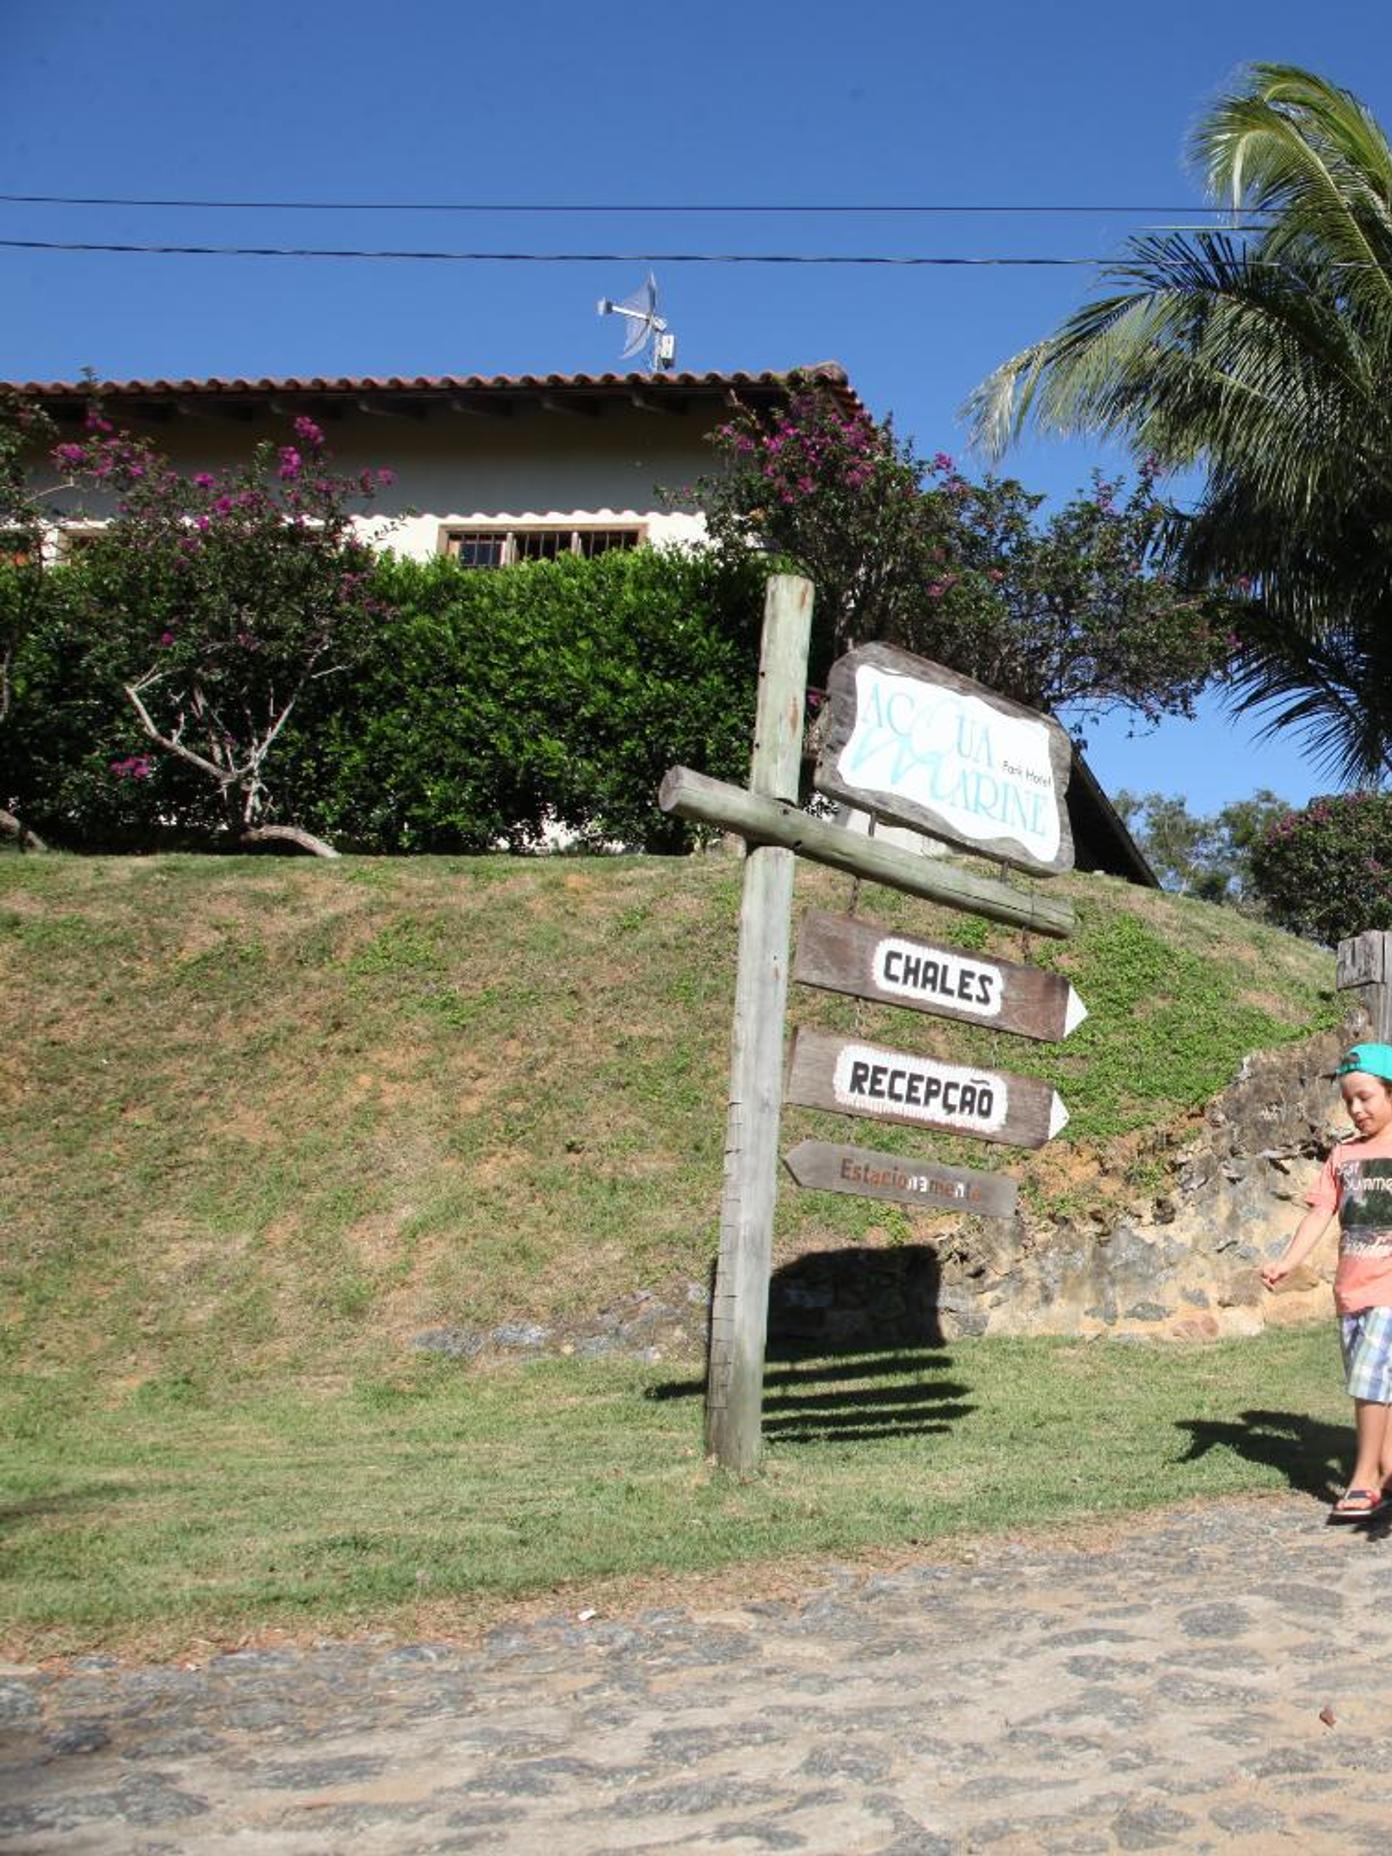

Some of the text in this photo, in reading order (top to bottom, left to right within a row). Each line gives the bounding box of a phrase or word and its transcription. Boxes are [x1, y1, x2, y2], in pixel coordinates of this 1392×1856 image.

[1025, 767, 1052, 788] Hotel
[883, 950, 994, 1006] CHALES
[850, 1061, 994, 1119] RECEPÇÃO
